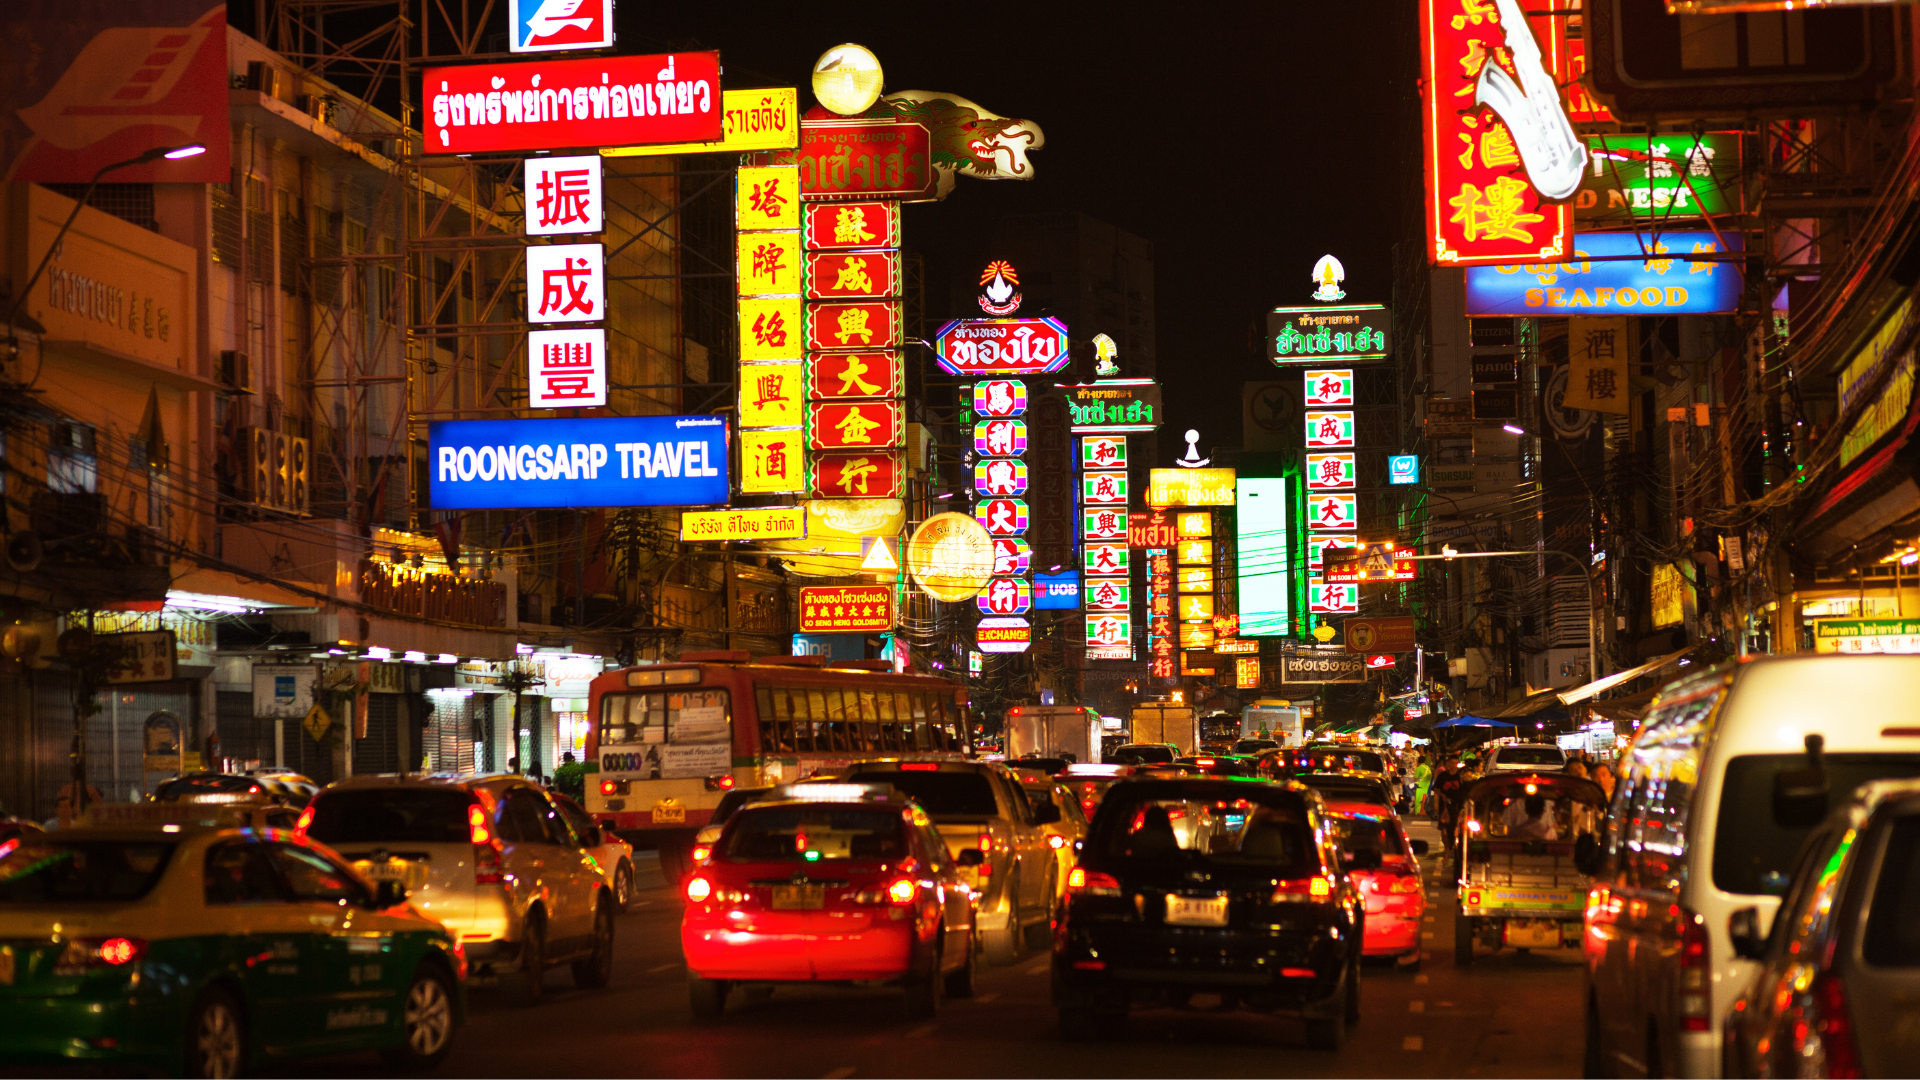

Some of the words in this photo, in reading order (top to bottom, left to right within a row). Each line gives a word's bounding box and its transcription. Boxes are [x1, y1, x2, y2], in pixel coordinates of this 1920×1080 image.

[433, 55, 711, 147] รุ่งทรัพย์การท่องเที่ยว
[804, 129, 906, 144] ห้างขายทอง
[1607, 187, 1692, 209] NEST
[536, 169, 596, 401] 振成豐
[1524, 286, 1688, 308] SEAFOOD
[1298, 314, 1360, 326] ห้างขายทอง
[954, 324, 1007, 339] ห้างทอง
[1473, 327, 1512, 337] CITIZEN
[831, 207, 883, 494] 蘇成興大金行
[1474, 362, 1513, 373] RADO
[1584, 328, 1618, 400] 酒樓
[1480, 398, 1510, 408] MIDO
[439, 444, 608, 482] ROONGSARP
[615, 441, 718, 479] TRAVEL
[1318, 377, 1345, 609] 和成興大行
[691, 517, 722, 534] บริษัท
[1432, 525, 1475, 538] BROADWAY
[1094, 442, 1119, 642] 和成興大金行
[1049, 583, 1078, 596] UOB
[804, 619, 814, 627] SO
[815, 619, 832, 627] SENG
[833, 618, 851, 627] HENG
[852, 618, 888, 626] GOLDSMITH
[978, 629, 1029, 641] EXCHANGE
